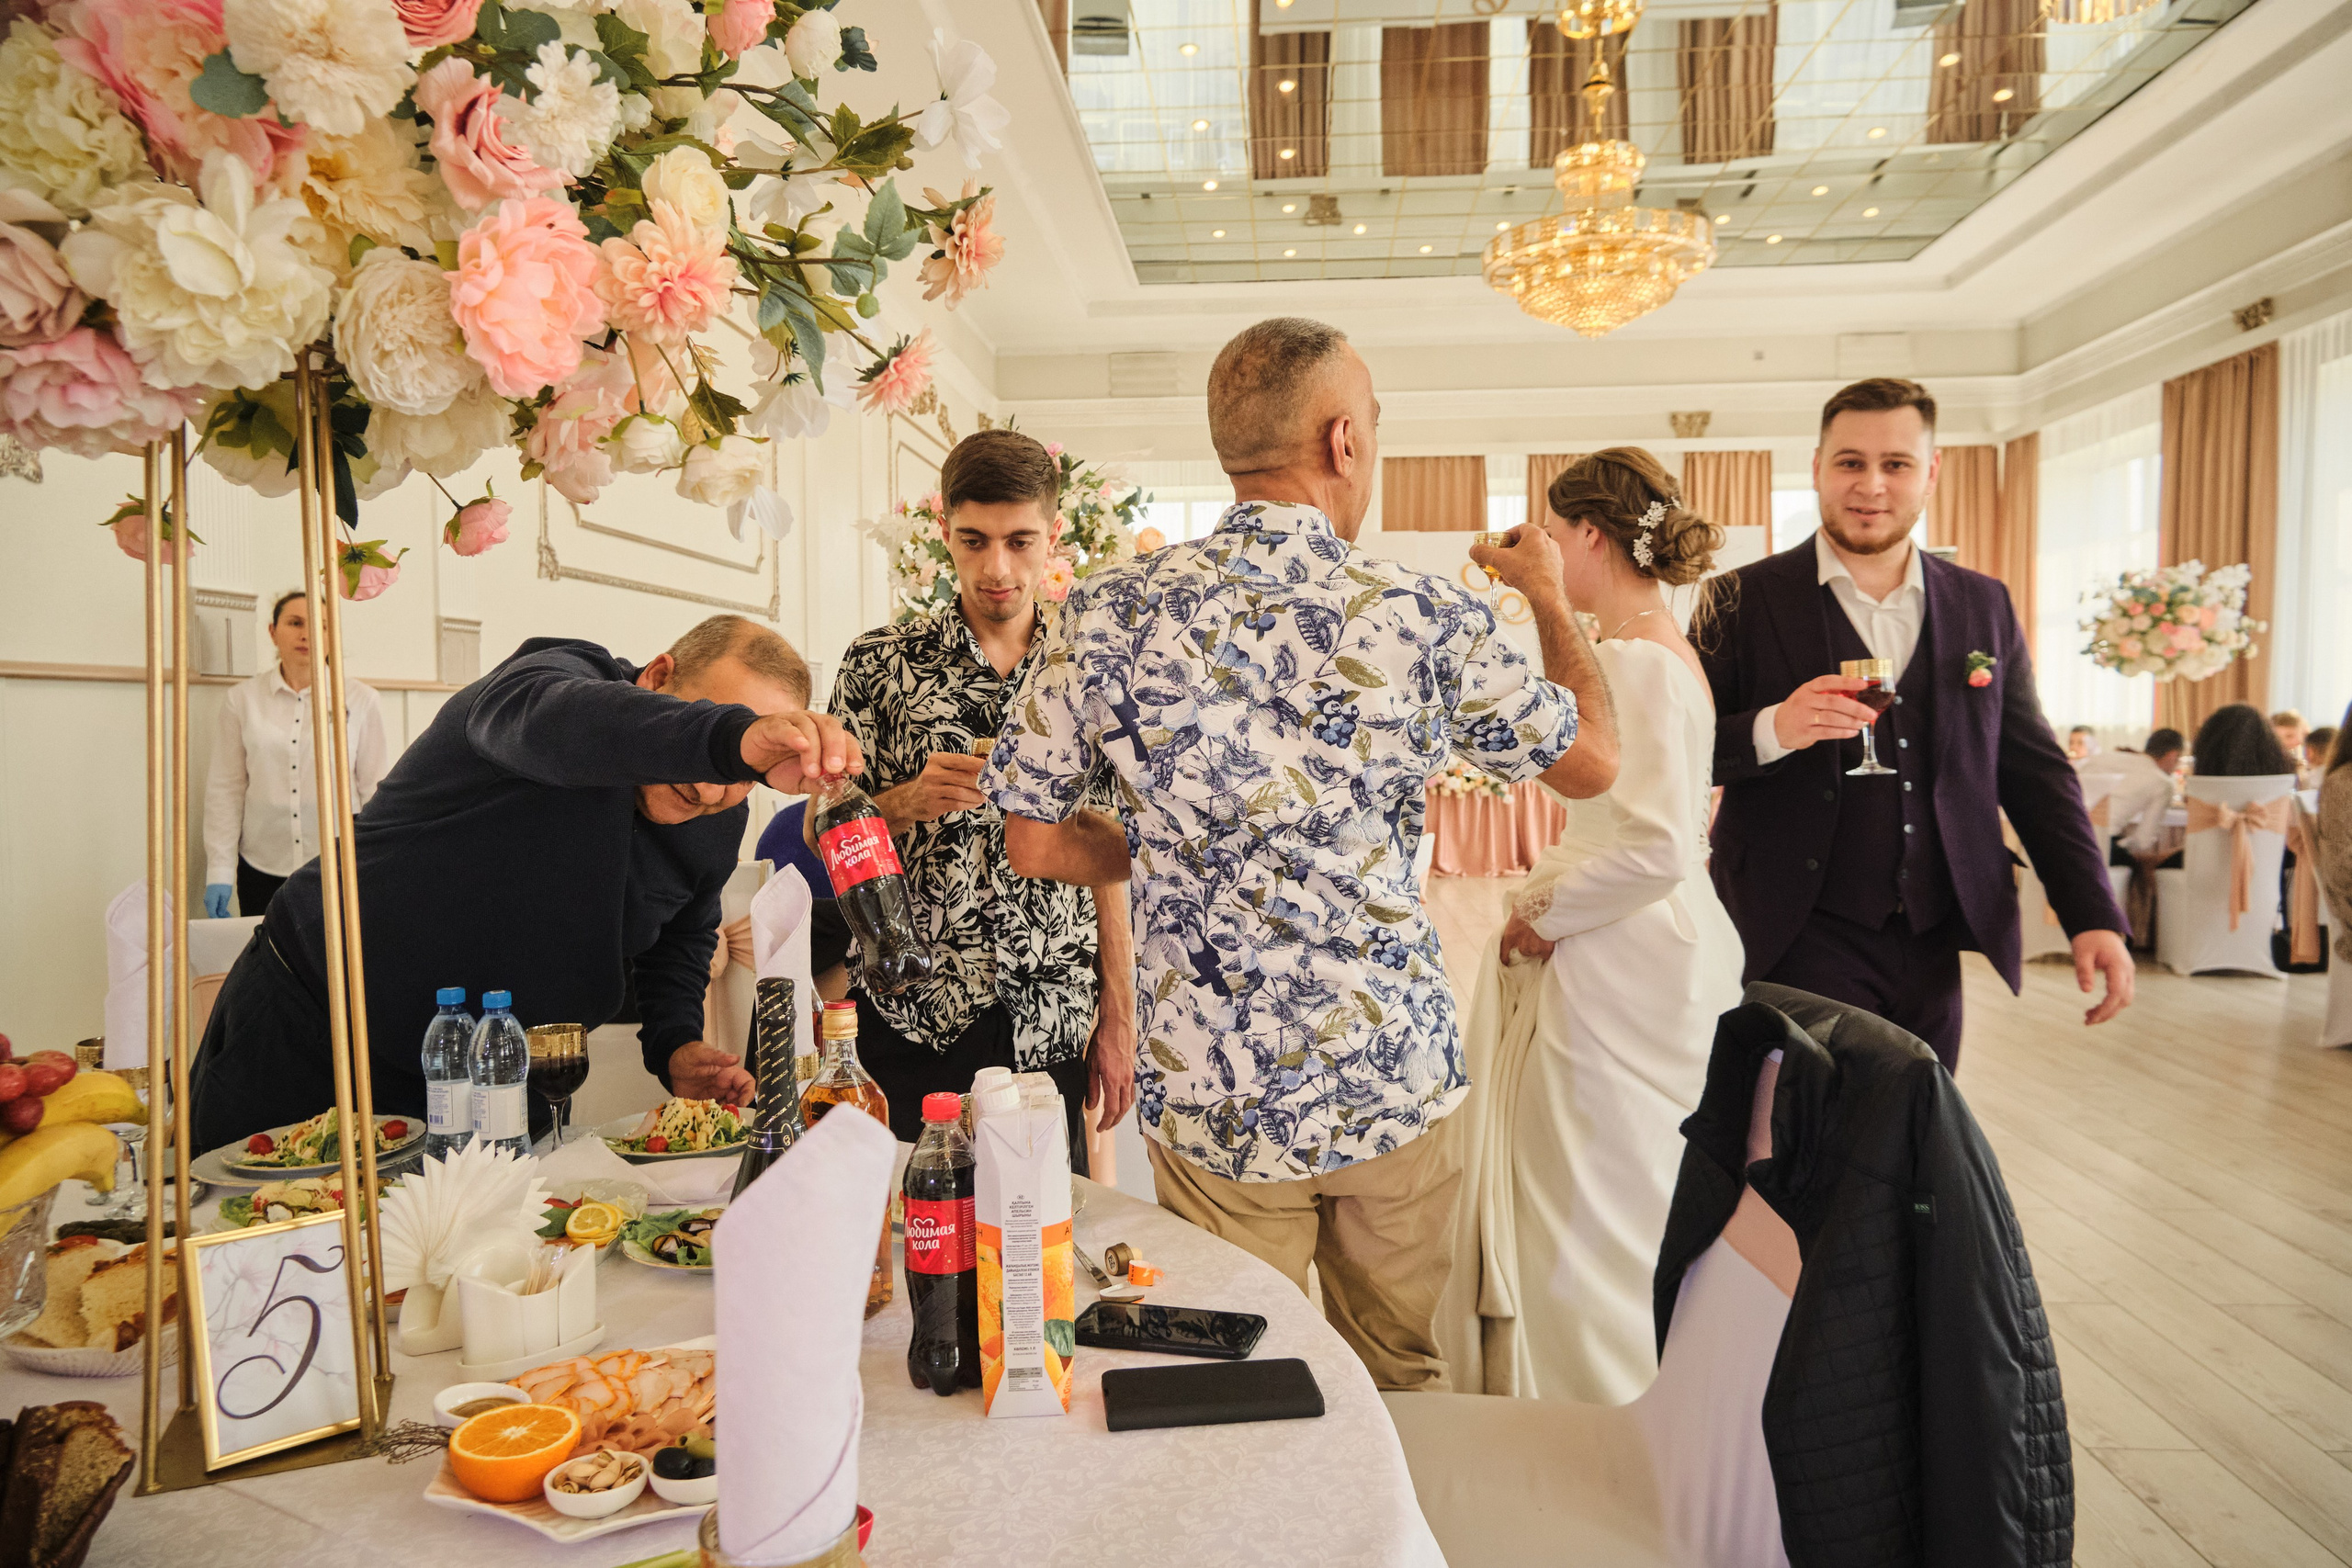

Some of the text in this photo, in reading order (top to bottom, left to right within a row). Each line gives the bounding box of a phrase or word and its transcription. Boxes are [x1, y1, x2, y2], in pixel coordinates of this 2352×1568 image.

[831, 834, 880, 872] Любимая
[844, 849, 872, 869] кола
[903, 1217, 956, 1238] Любимая
[912, 1239, 940, 1250] кола
[217, 1245, 345, 1420] 5
